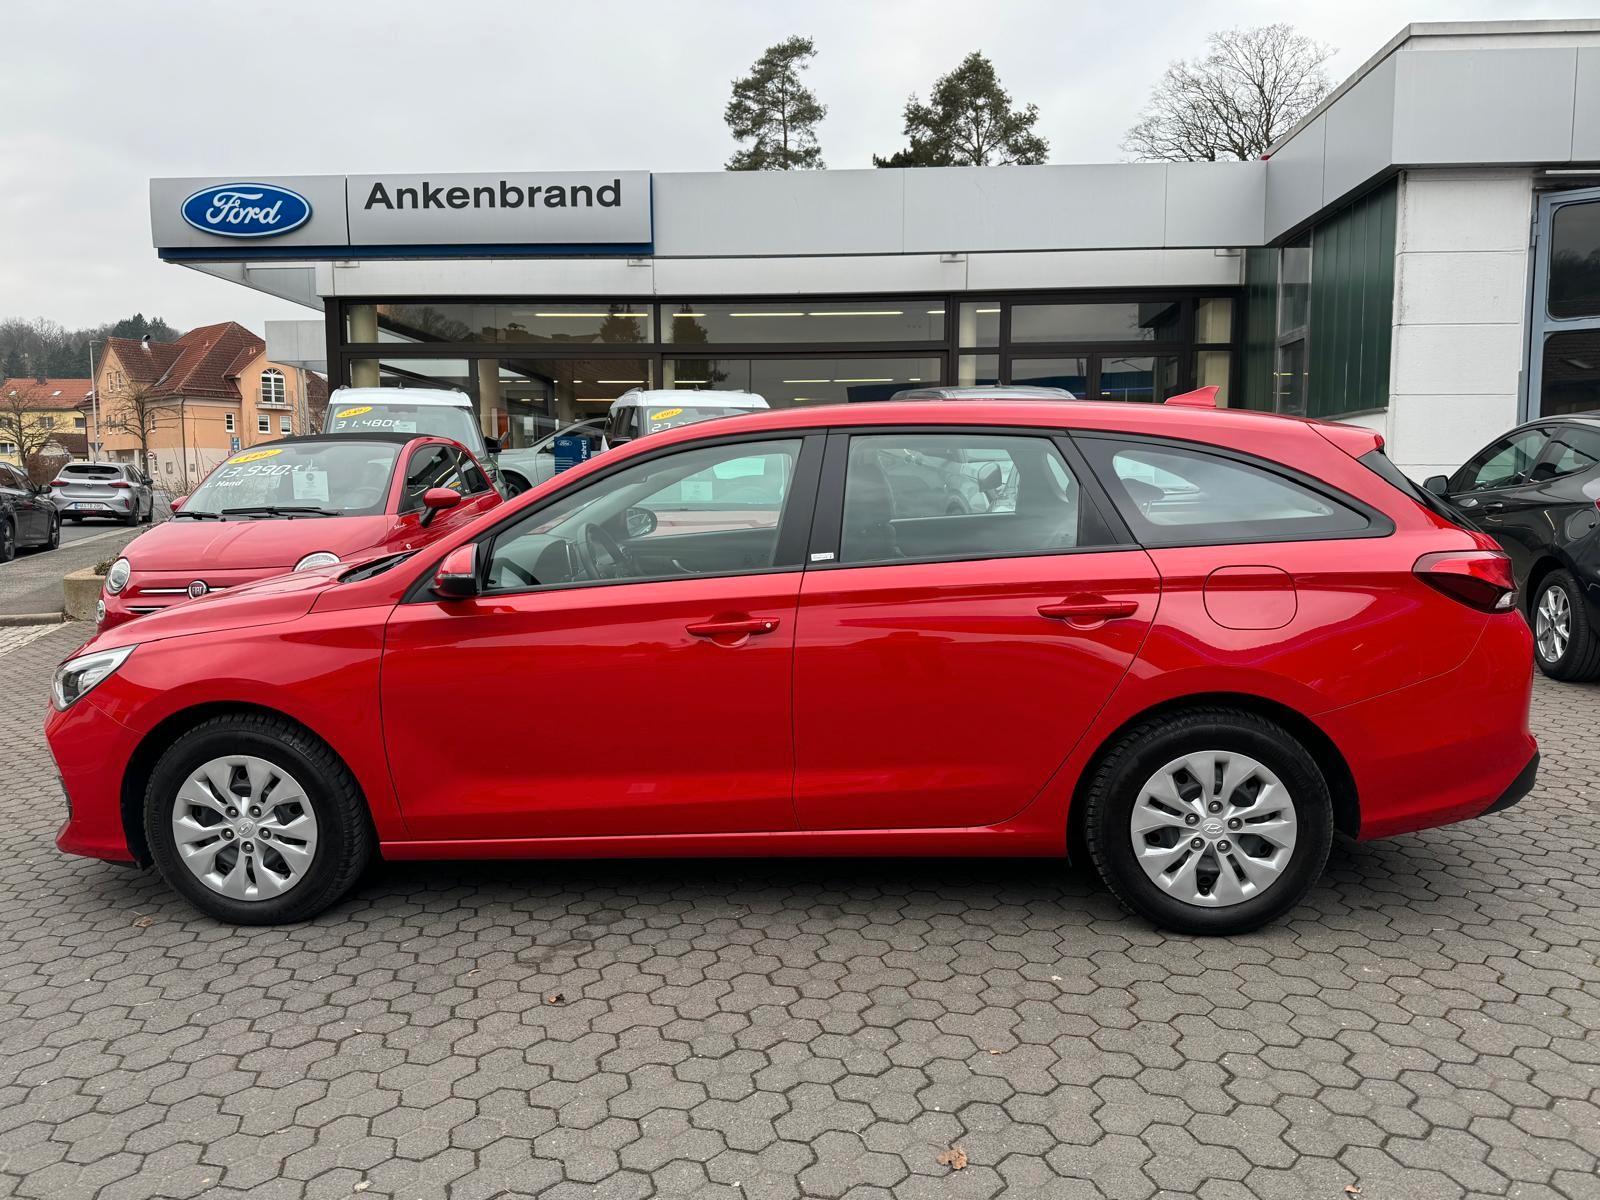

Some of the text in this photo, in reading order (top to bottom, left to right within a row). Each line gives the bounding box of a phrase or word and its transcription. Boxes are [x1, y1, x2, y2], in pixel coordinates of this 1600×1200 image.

[205, 191, 283, 224] Ford
[364, 179, 621, 209] Ankenbrand
[215, 479, 244, 488] Hand
